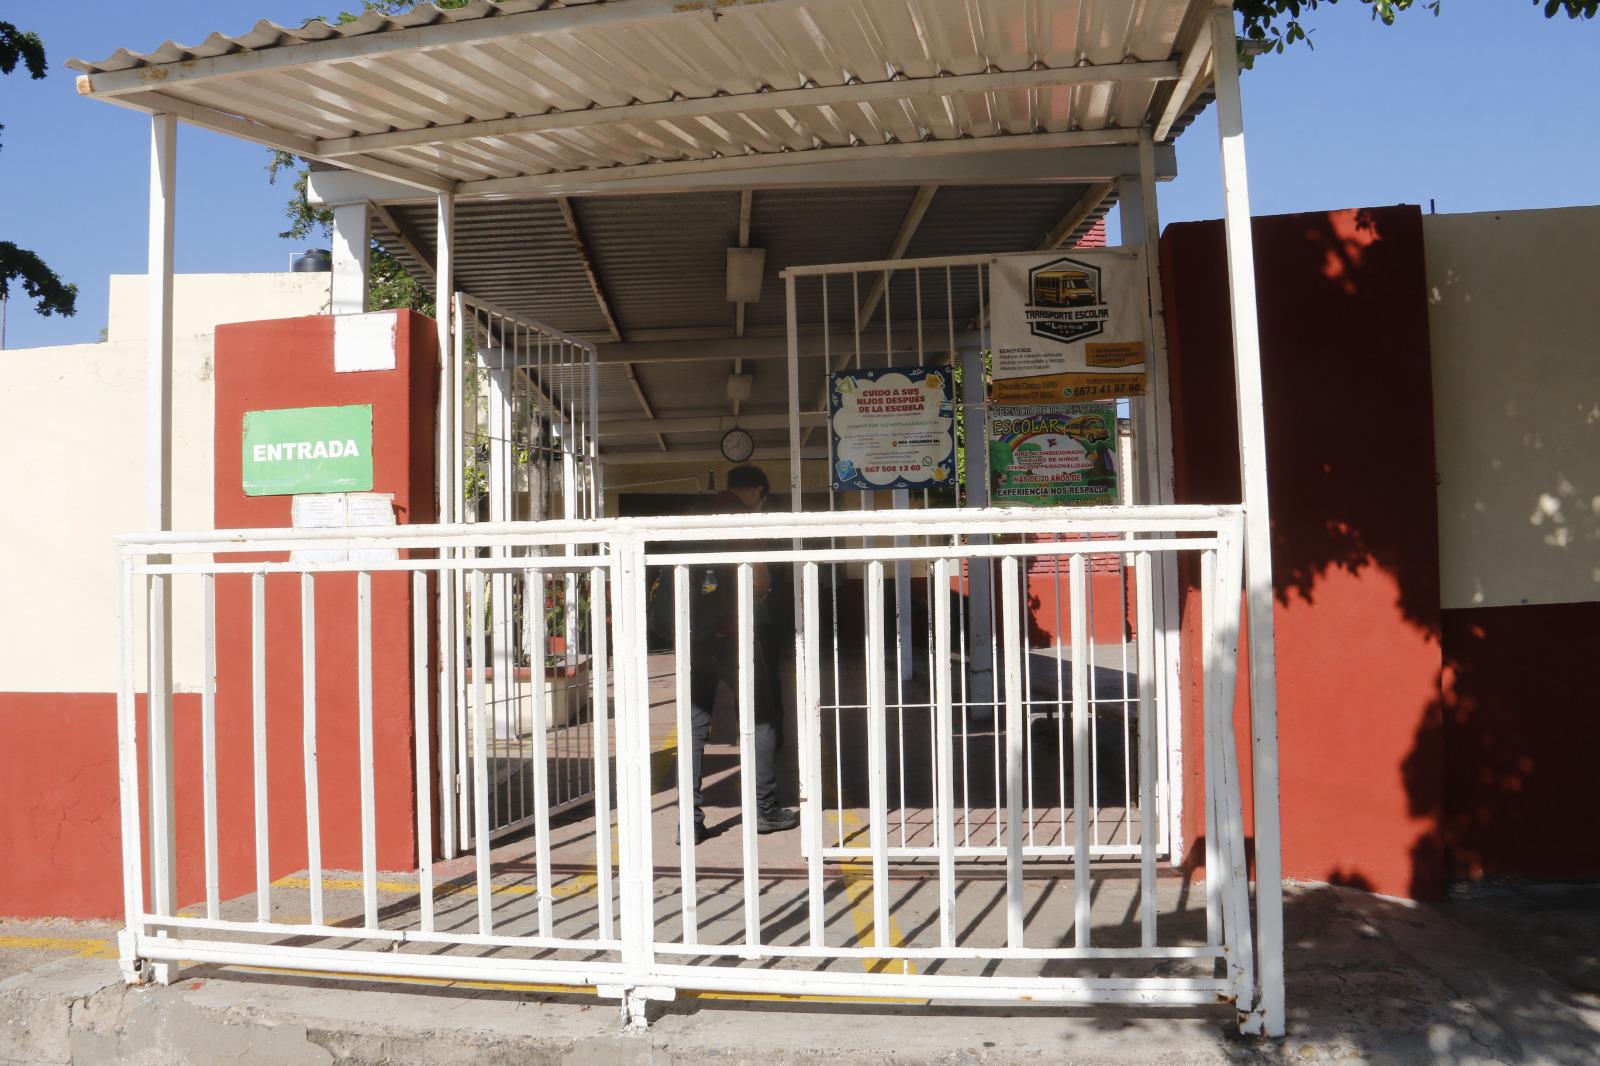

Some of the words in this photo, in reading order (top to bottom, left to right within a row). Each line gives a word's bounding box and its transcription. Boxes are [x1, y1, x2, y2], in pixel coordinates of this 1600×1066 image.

[1025, 309, 1073, 320] TRANSPORTE
[1075, 308, 1109, 319] ESCOLAR
[863, 389, 891, 397] CUIDO
[893, 388, 900, 396] A
[901, 388, 919, 396] SUS
[857, 397, 884, 405] HIJOS
[886, 395, 925, 404] DESPUÉS
[885, 403, 925, 412] ESCUELA
[993, 419, 1060, 436] ESCOLAR
[253, 439, 360, 462] ENTRADA
[1051, 473, 1069, 482] AÑOS
[997, 488, 1049, 497] EXPERIENCIA
[1051, 487, 1067, 495] NOS
[1069, 486, 1109, 495] RESPALDA
